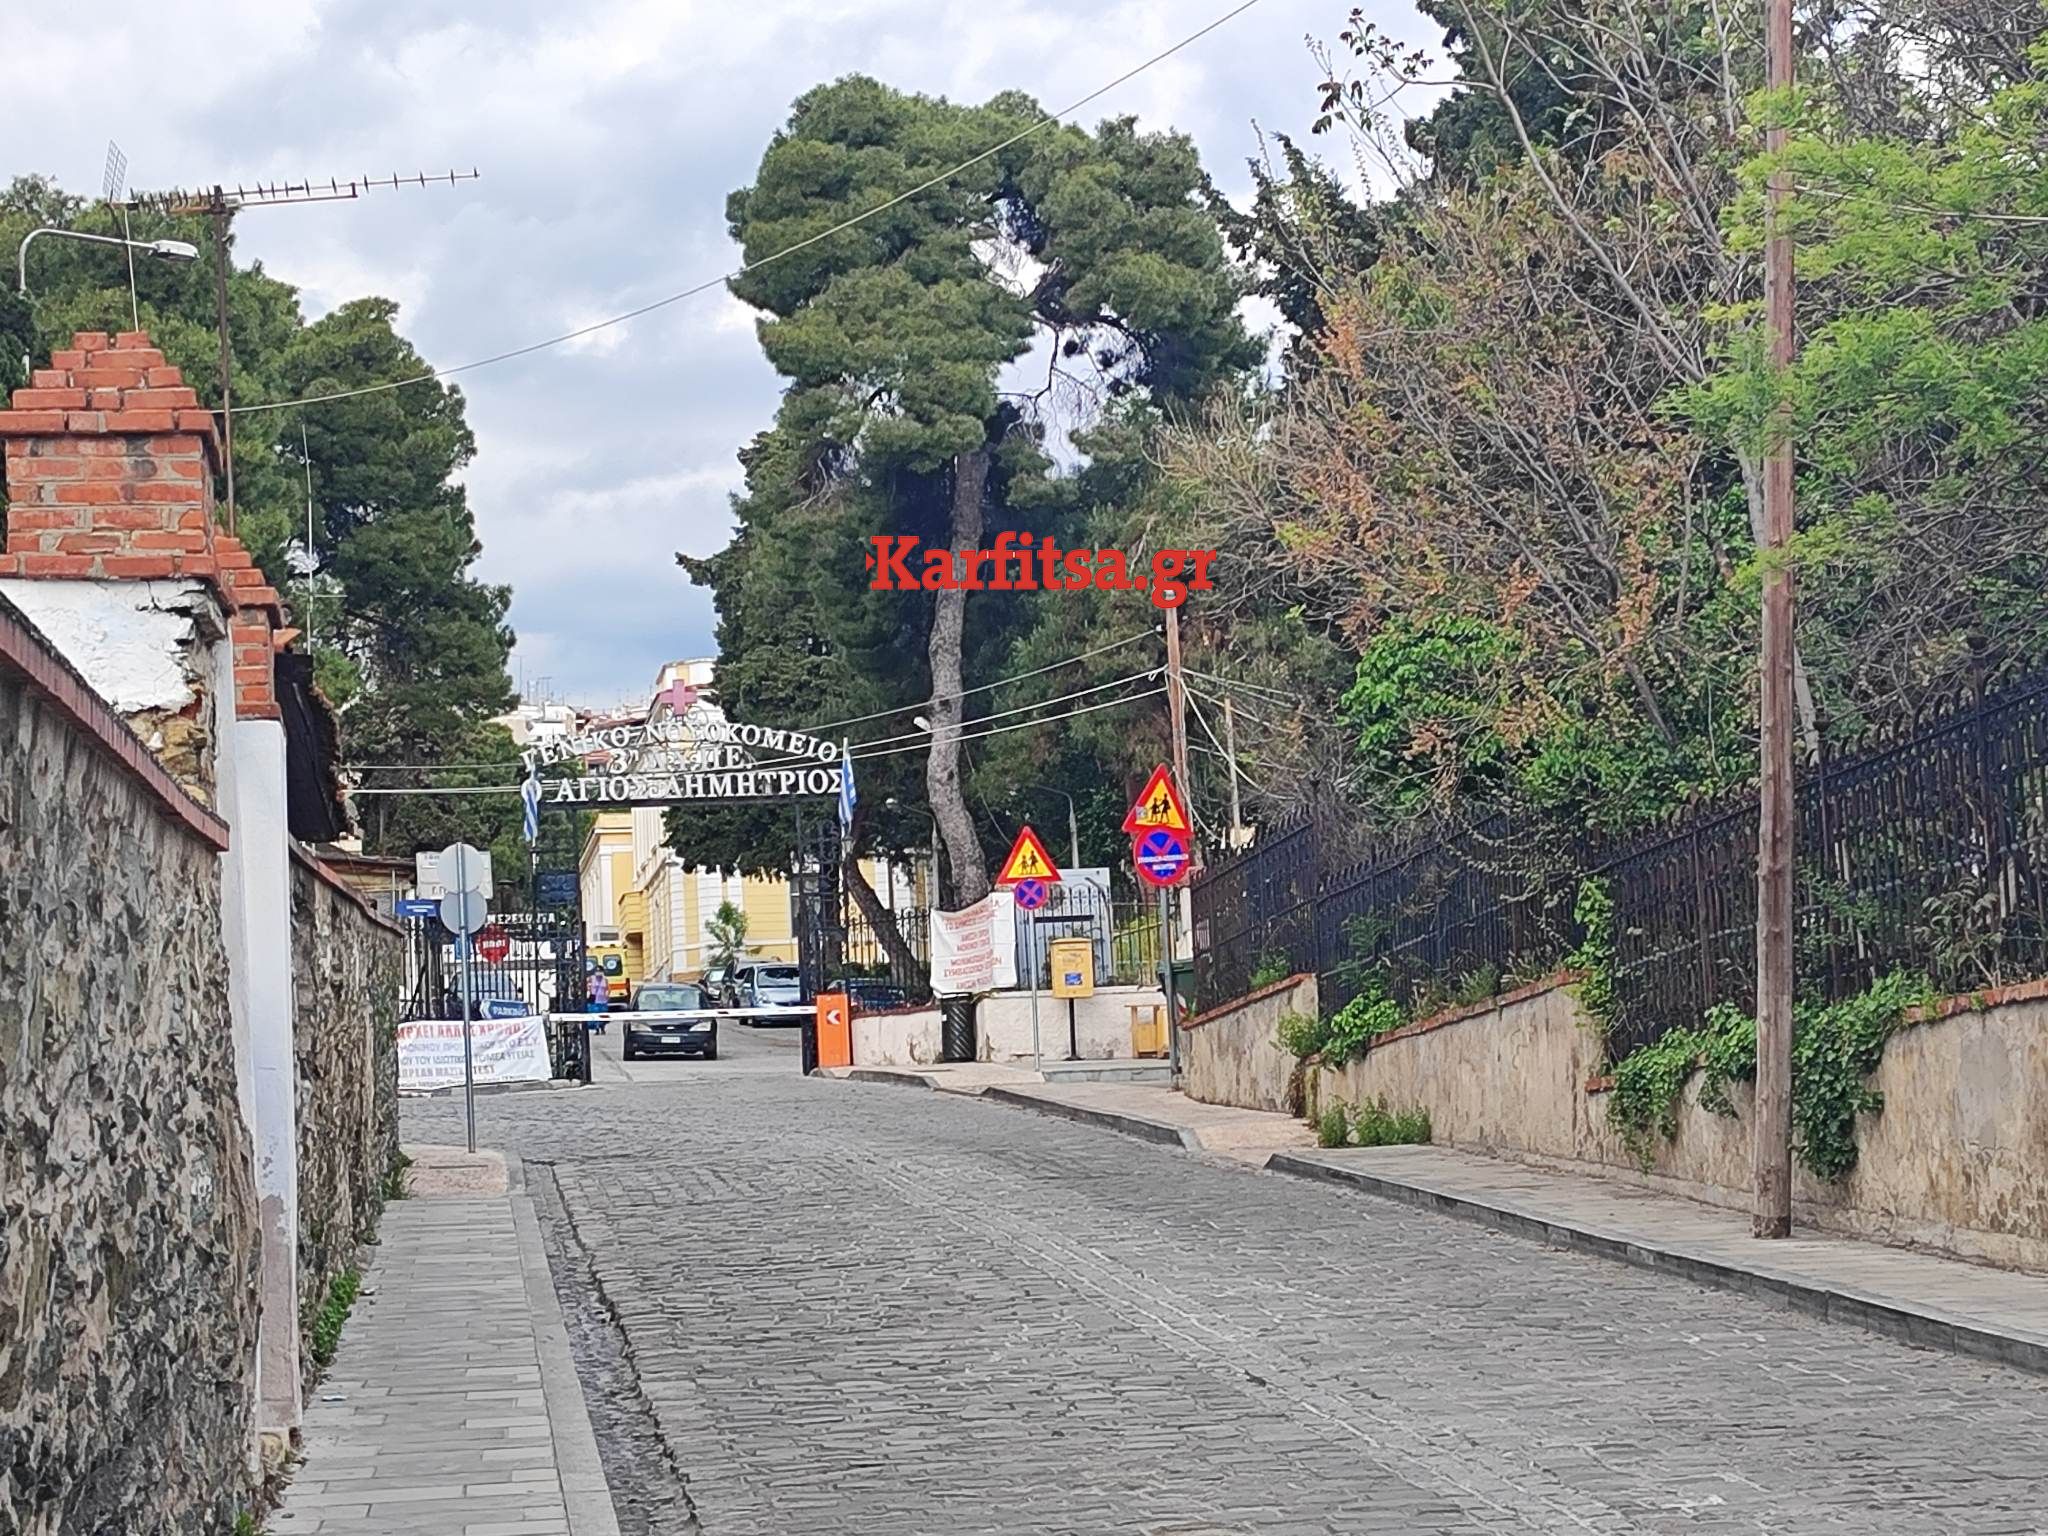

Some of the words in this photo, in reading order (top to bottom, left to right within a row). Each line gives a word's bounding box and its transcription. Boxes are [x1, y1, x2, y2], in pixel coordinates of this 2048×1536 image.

[520, 726, 629, 771] ΓΕΝΙΚΟ
[642, 721, 838, 763] ΝΟΣΟΚΟΜΕΙΟ
[549, 776, 646, 803] ΑΓΙΟΣ
[664, 769, 843, 798] ΔΗΜΗΤΡΙΟΣ
[492, 1006, 528, 1017] PARKING
